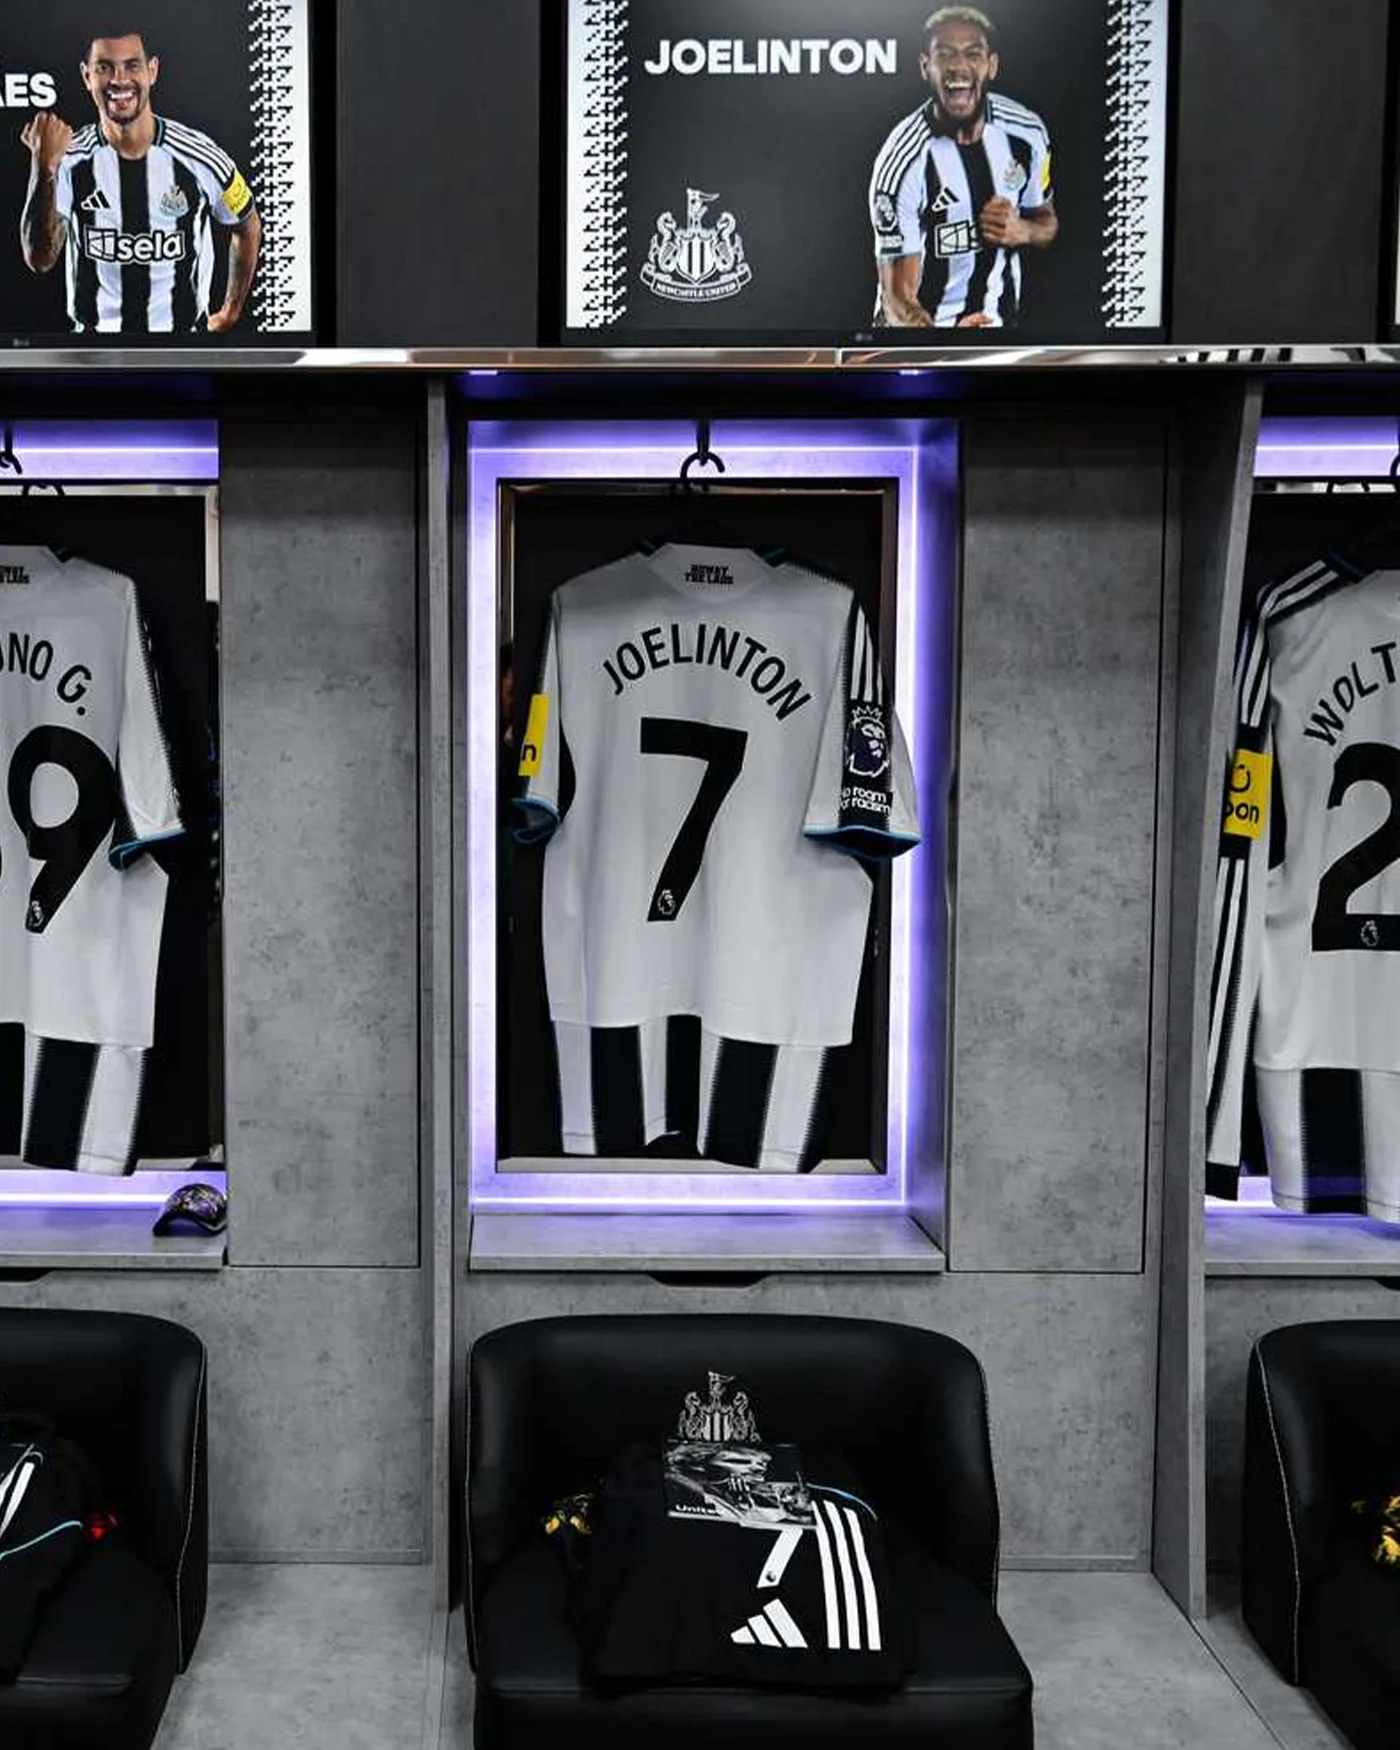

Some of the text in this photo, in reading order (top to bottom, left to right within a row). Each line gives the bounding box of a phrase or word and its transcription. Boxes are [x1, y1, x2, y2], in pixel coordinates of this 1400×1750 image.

[645, 38, 897, 75] JOELINTON
[0, 73, 57, 108] ES
[117, 232, 181, 260] sela
[0, 632, 92, 716] NO G.
[603, 623, 813, 722] JOELINTON
[1303, 641, 1397, 746] WOLT
[640, 717, 748, 922] 7
[852, 797, 891, 816] racism
[853, 786, 886, 803] room
[0, 724, 117, 934] 9
